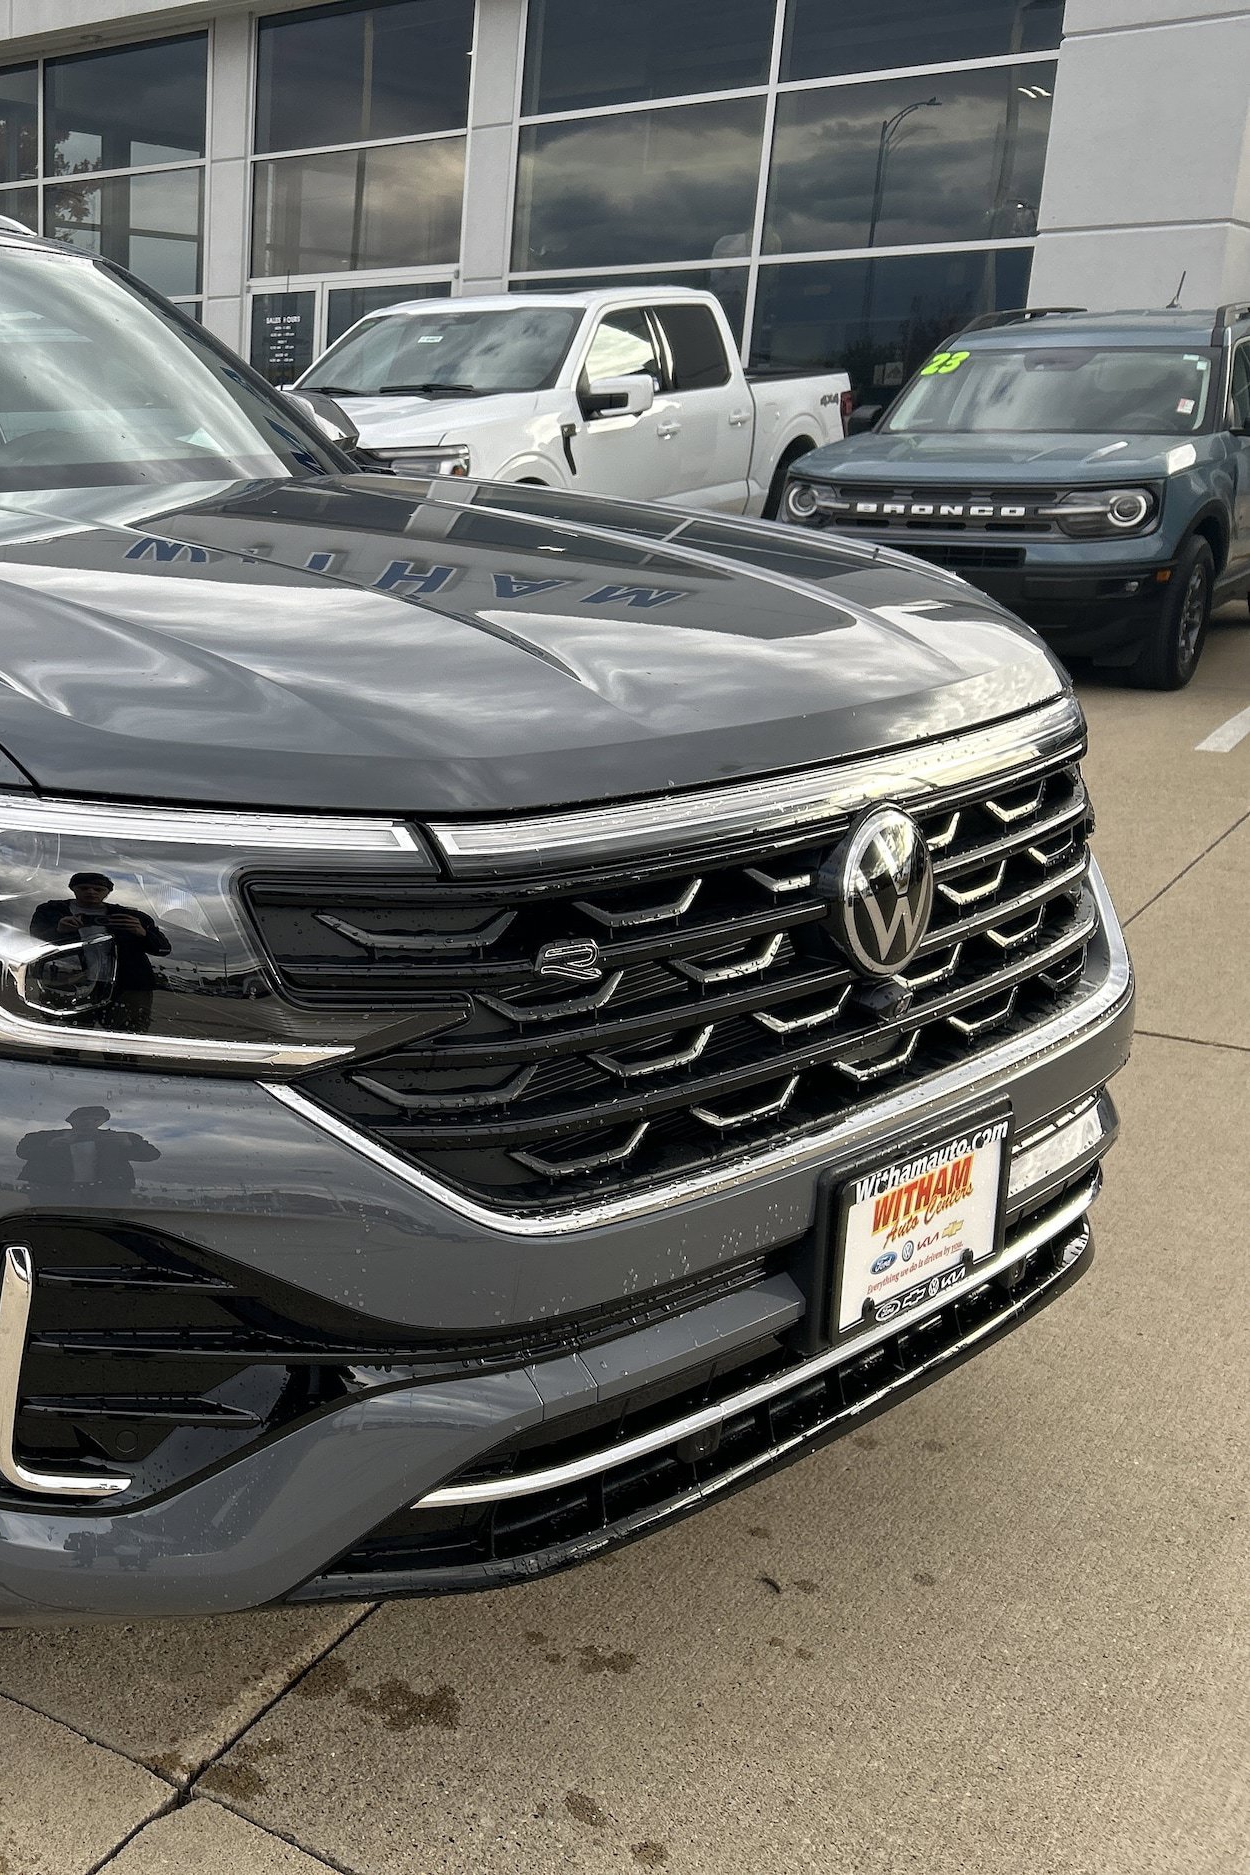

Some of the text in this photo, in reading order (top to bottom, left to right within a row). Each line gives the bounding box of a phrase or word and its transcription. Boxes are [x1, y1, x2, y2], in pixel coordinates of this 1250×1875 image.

[920, 350, 971, 376] 23
[856, 502, 1026, 517] BRONCO
[872, 1154, 974, 1235] WITHAM
[883, 1181, 974, 1249] Auto Centers
[866, 1270, 900, 1295] Everything
[923, 1249, 943, 1266] driven
